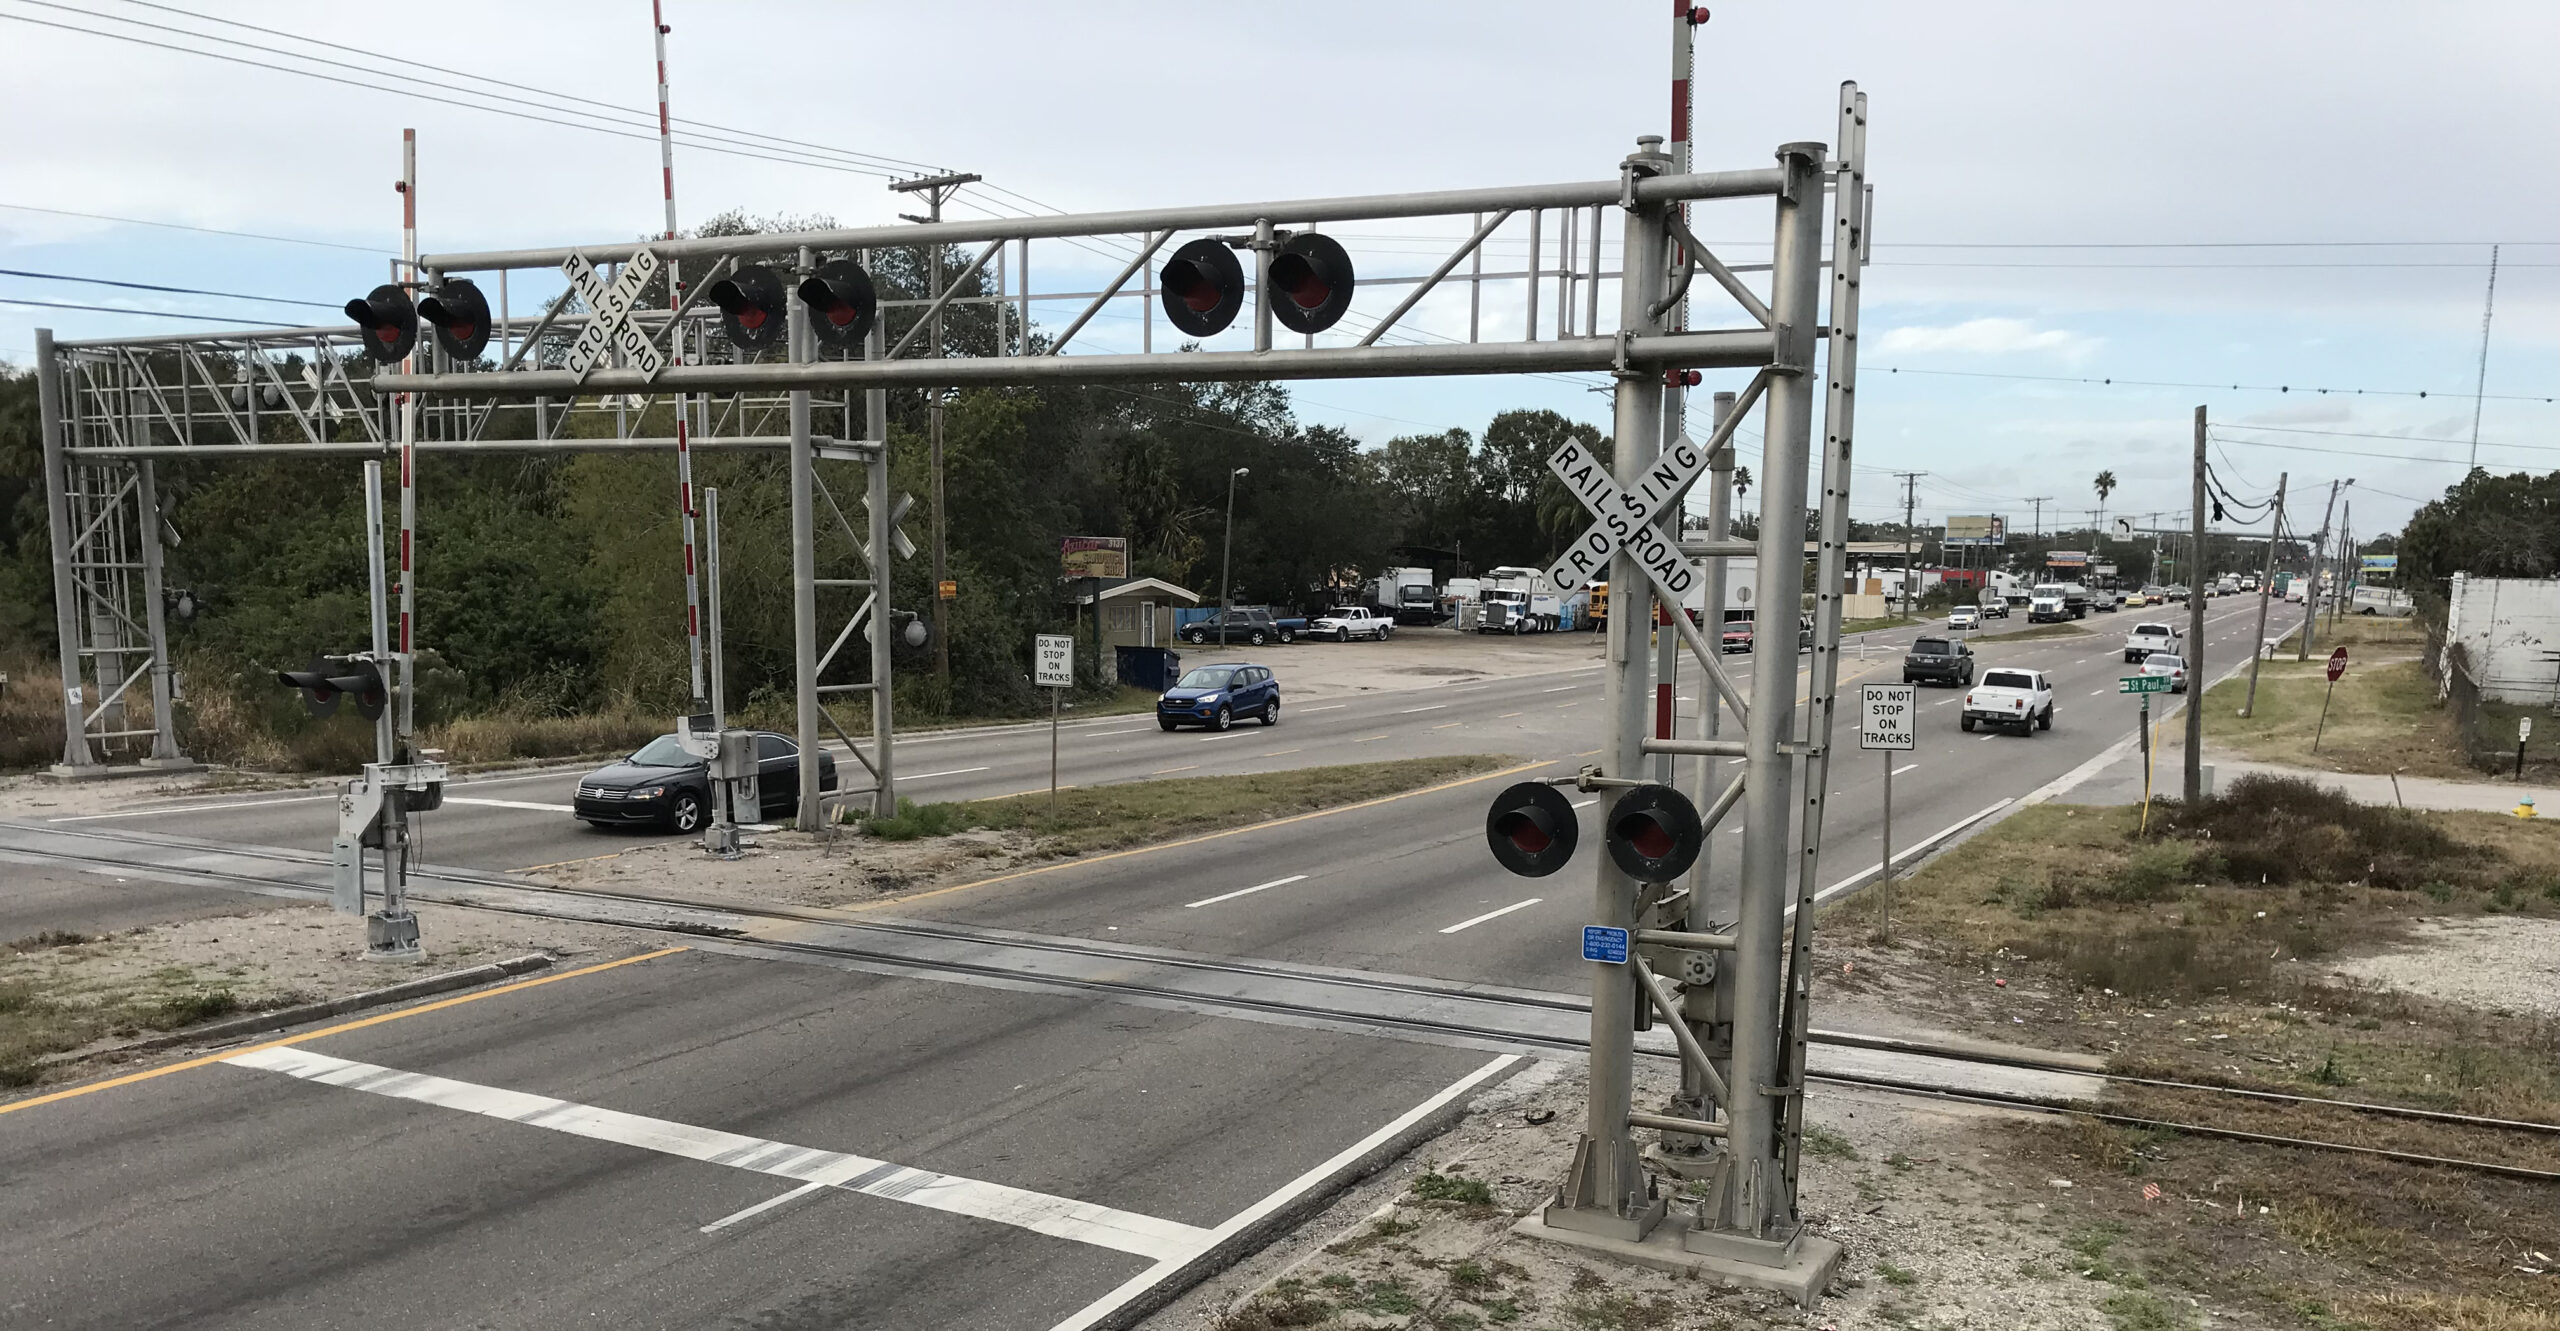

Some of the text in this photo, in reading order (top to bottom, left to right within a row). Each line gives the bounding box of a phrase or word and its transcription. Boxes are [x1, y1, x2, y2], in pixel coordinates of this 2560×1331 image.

[569, 252, 652, 374] CROSSING
[1553, 445, 1697, 590] CROSSING
[1108, 540, 1124, 548] 3137
[1104, 564, 1124, 576] SHOP
[1038, 639, 1070, 649] DO NOT
[1043, 650, 1065, 659] STOP
[1048, 661, 1060, 670] ON
[2328, 657, 2347, 672] STOP
[1038, 671, 1070, 682] TRACKS
[2130, 680, 2139, 691] St
[2142, 679, 2159, 690] Paul
[1867, 691, 1911, 702] DO NOT
[1873, 705, 1904, 715] STOP
[1879, 719, 1897, 729] ON
[1864, 732, 1911, 744] TRACKS
